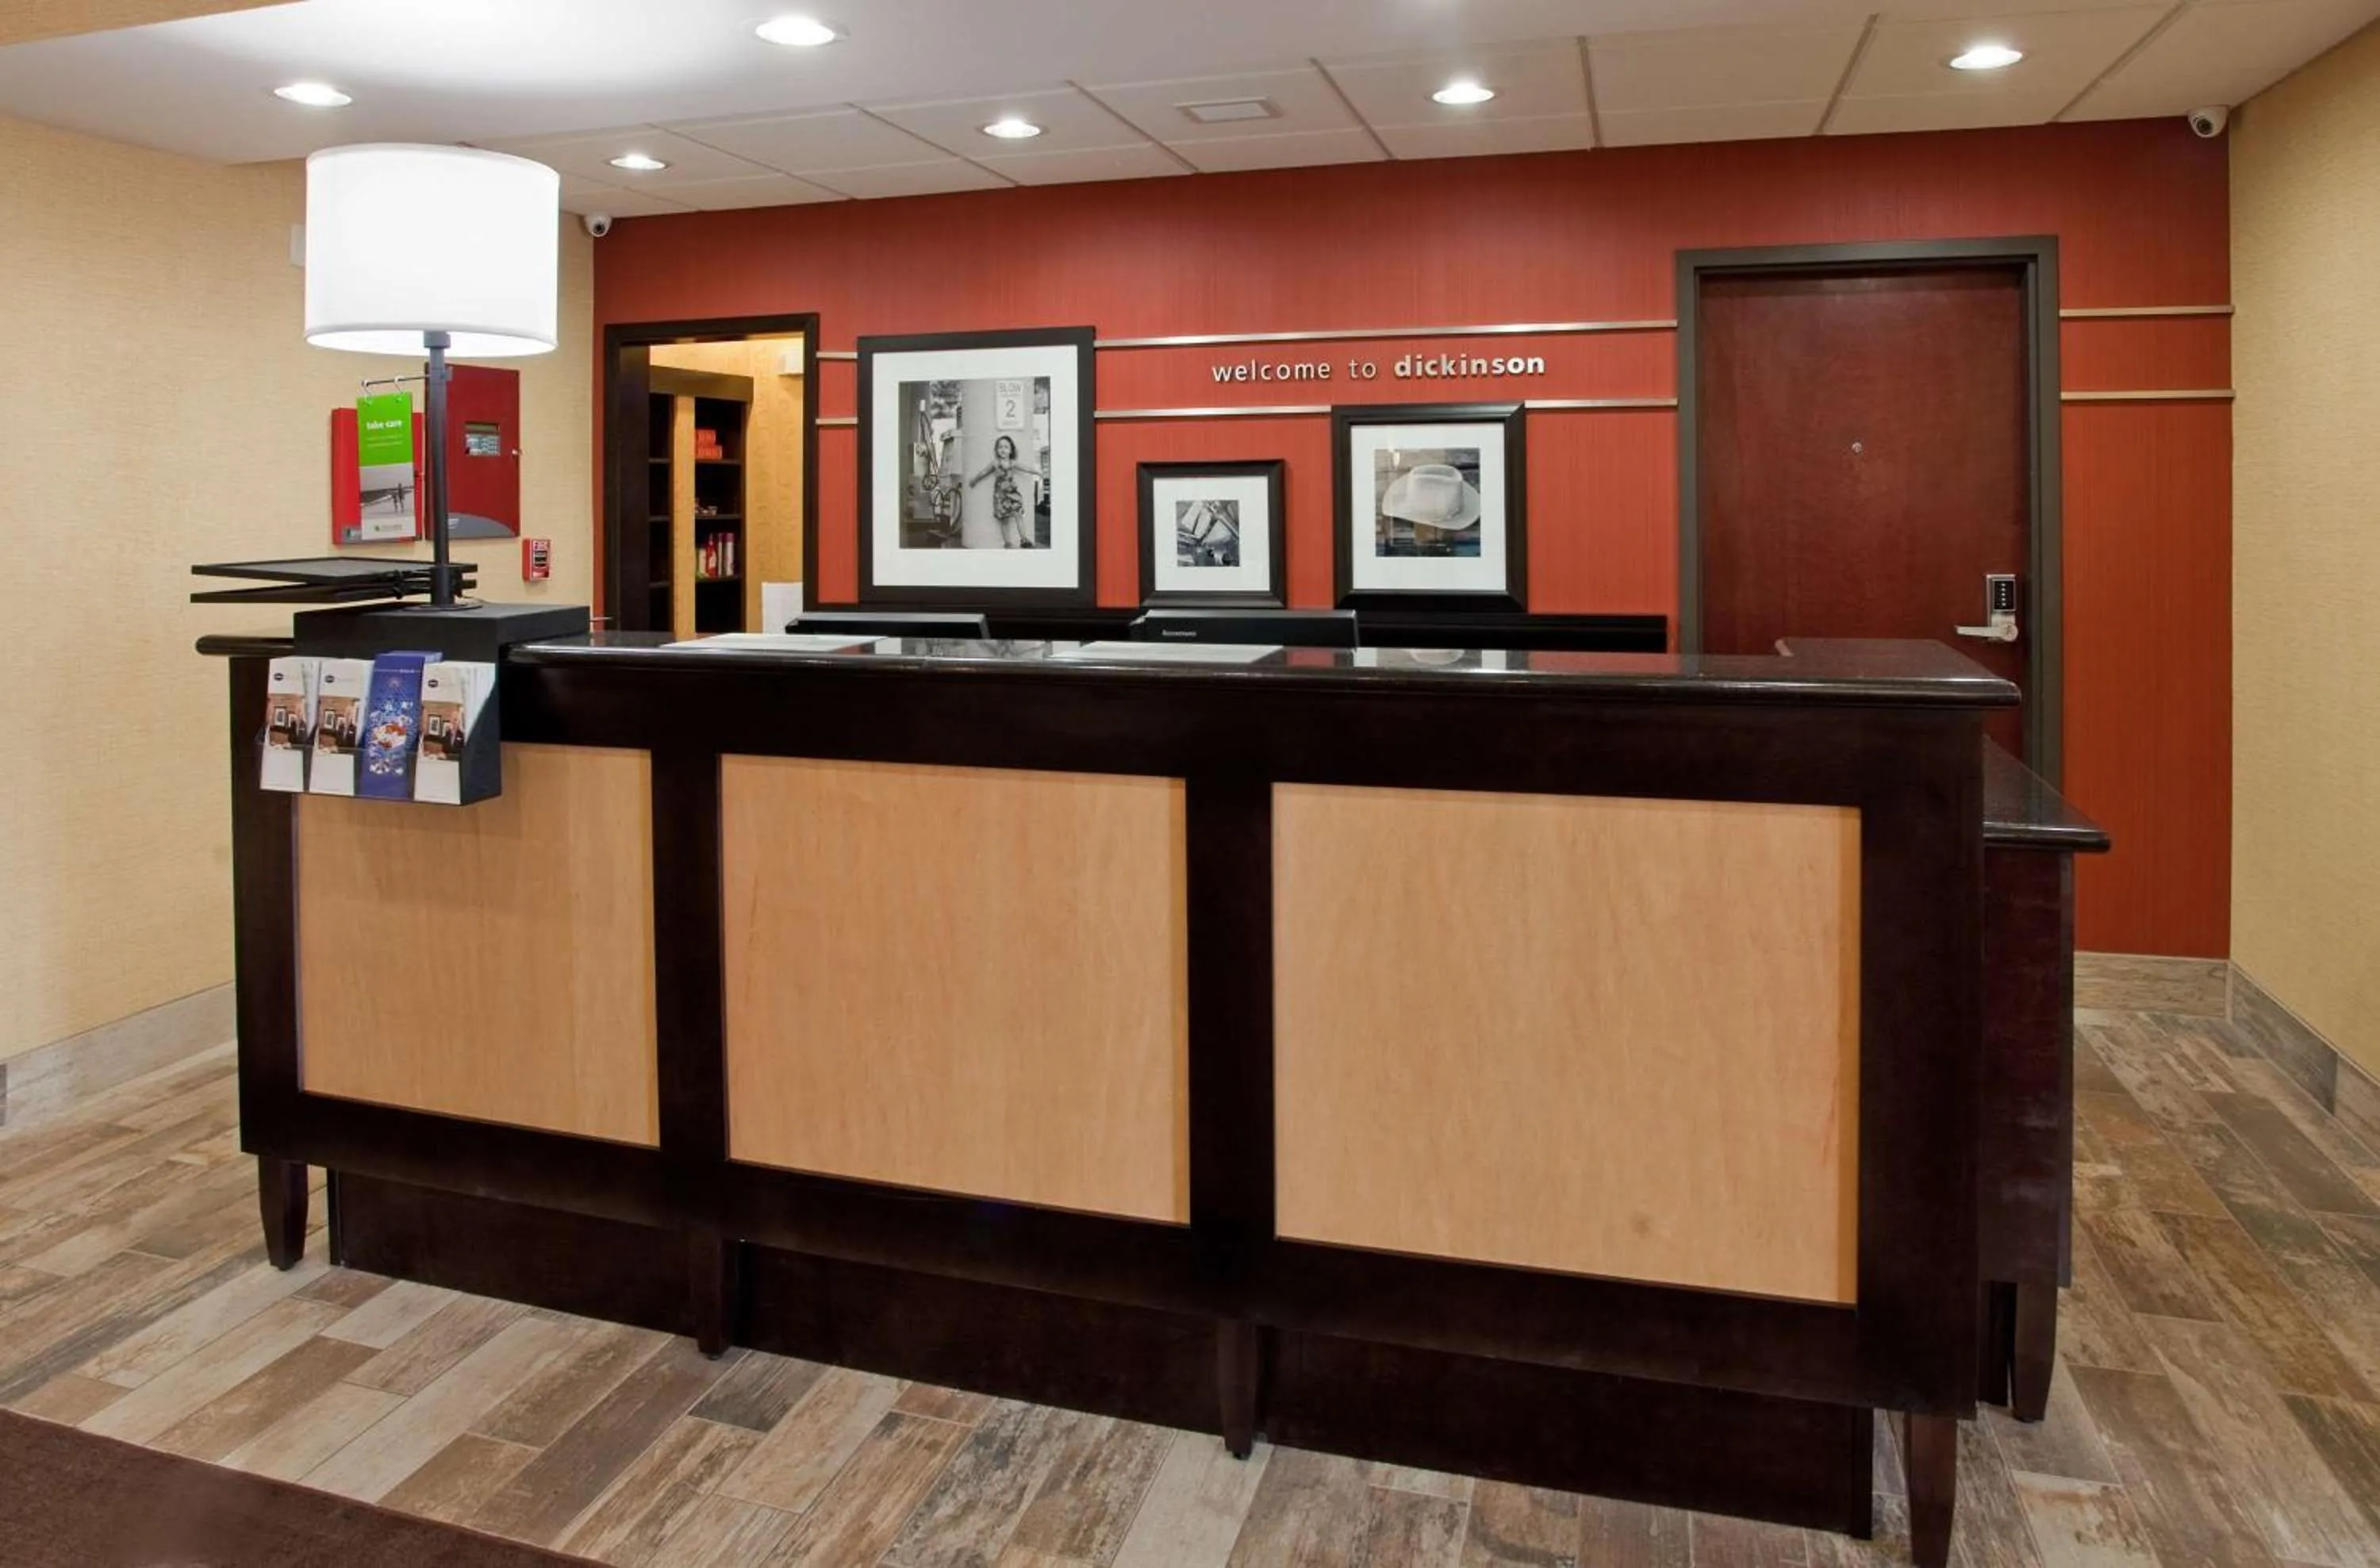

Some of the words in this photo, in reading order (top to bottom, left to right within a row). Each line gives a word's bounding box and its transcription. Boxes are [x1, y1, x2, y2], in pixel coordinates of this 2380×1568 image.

[1211, 358, 1331, 382] welcome
[1348, 359, 1377, 379] to
[1393, 353, 1545, 378] dickinson
[1005, 399, 1016, 418] 2
